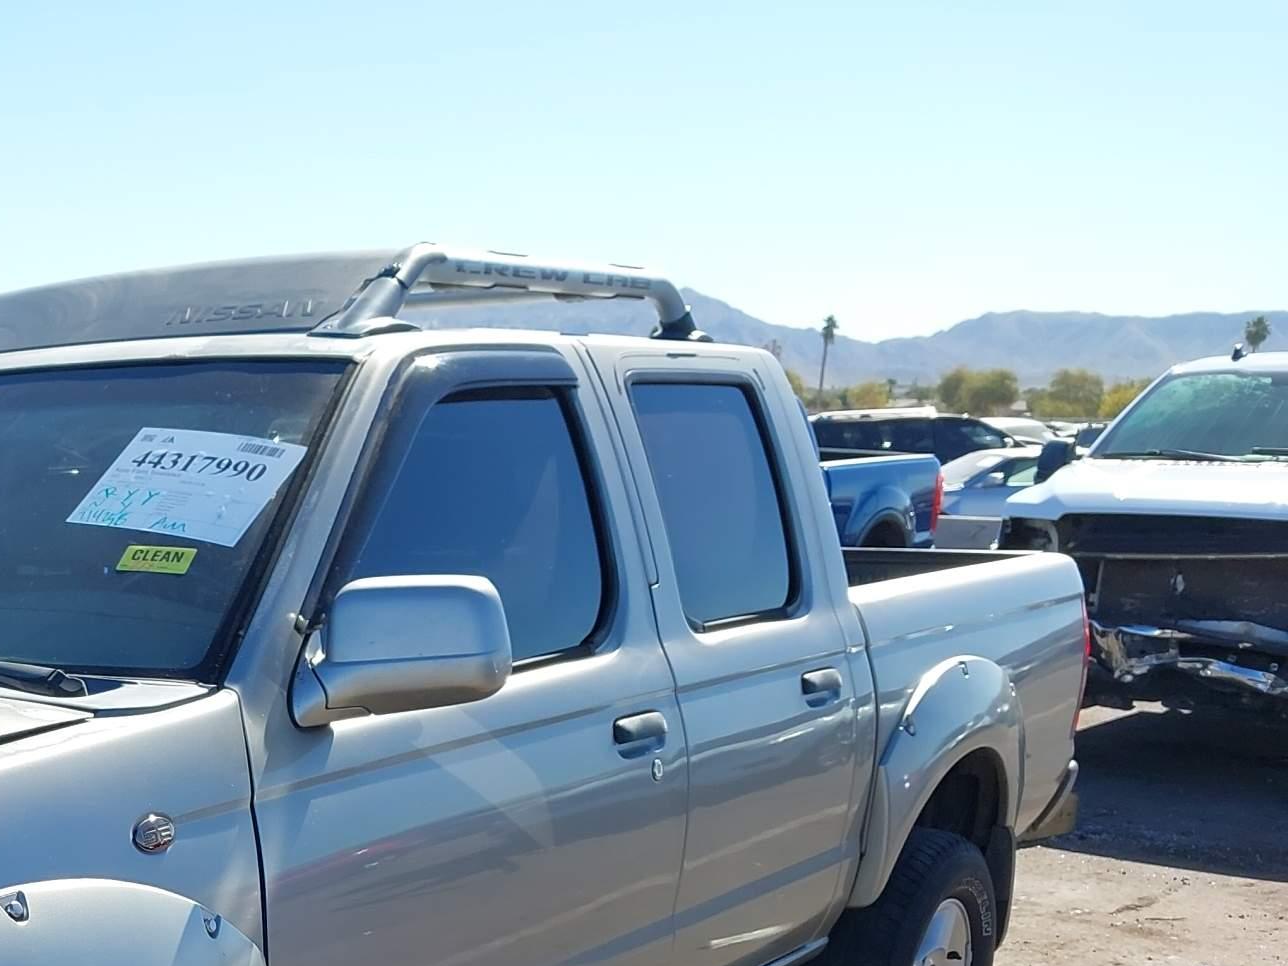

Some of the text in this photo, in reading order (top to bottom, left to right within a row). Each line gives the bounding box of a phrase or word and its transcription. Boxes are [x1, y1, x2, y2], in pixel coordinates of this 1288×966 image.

[454, 260, 652, 290] CREW CAB
[165, 300, 316, 326] NISSAN
[132, 450, 267, 482] 44317990
[131, 549, 185, 563] CLEAN
